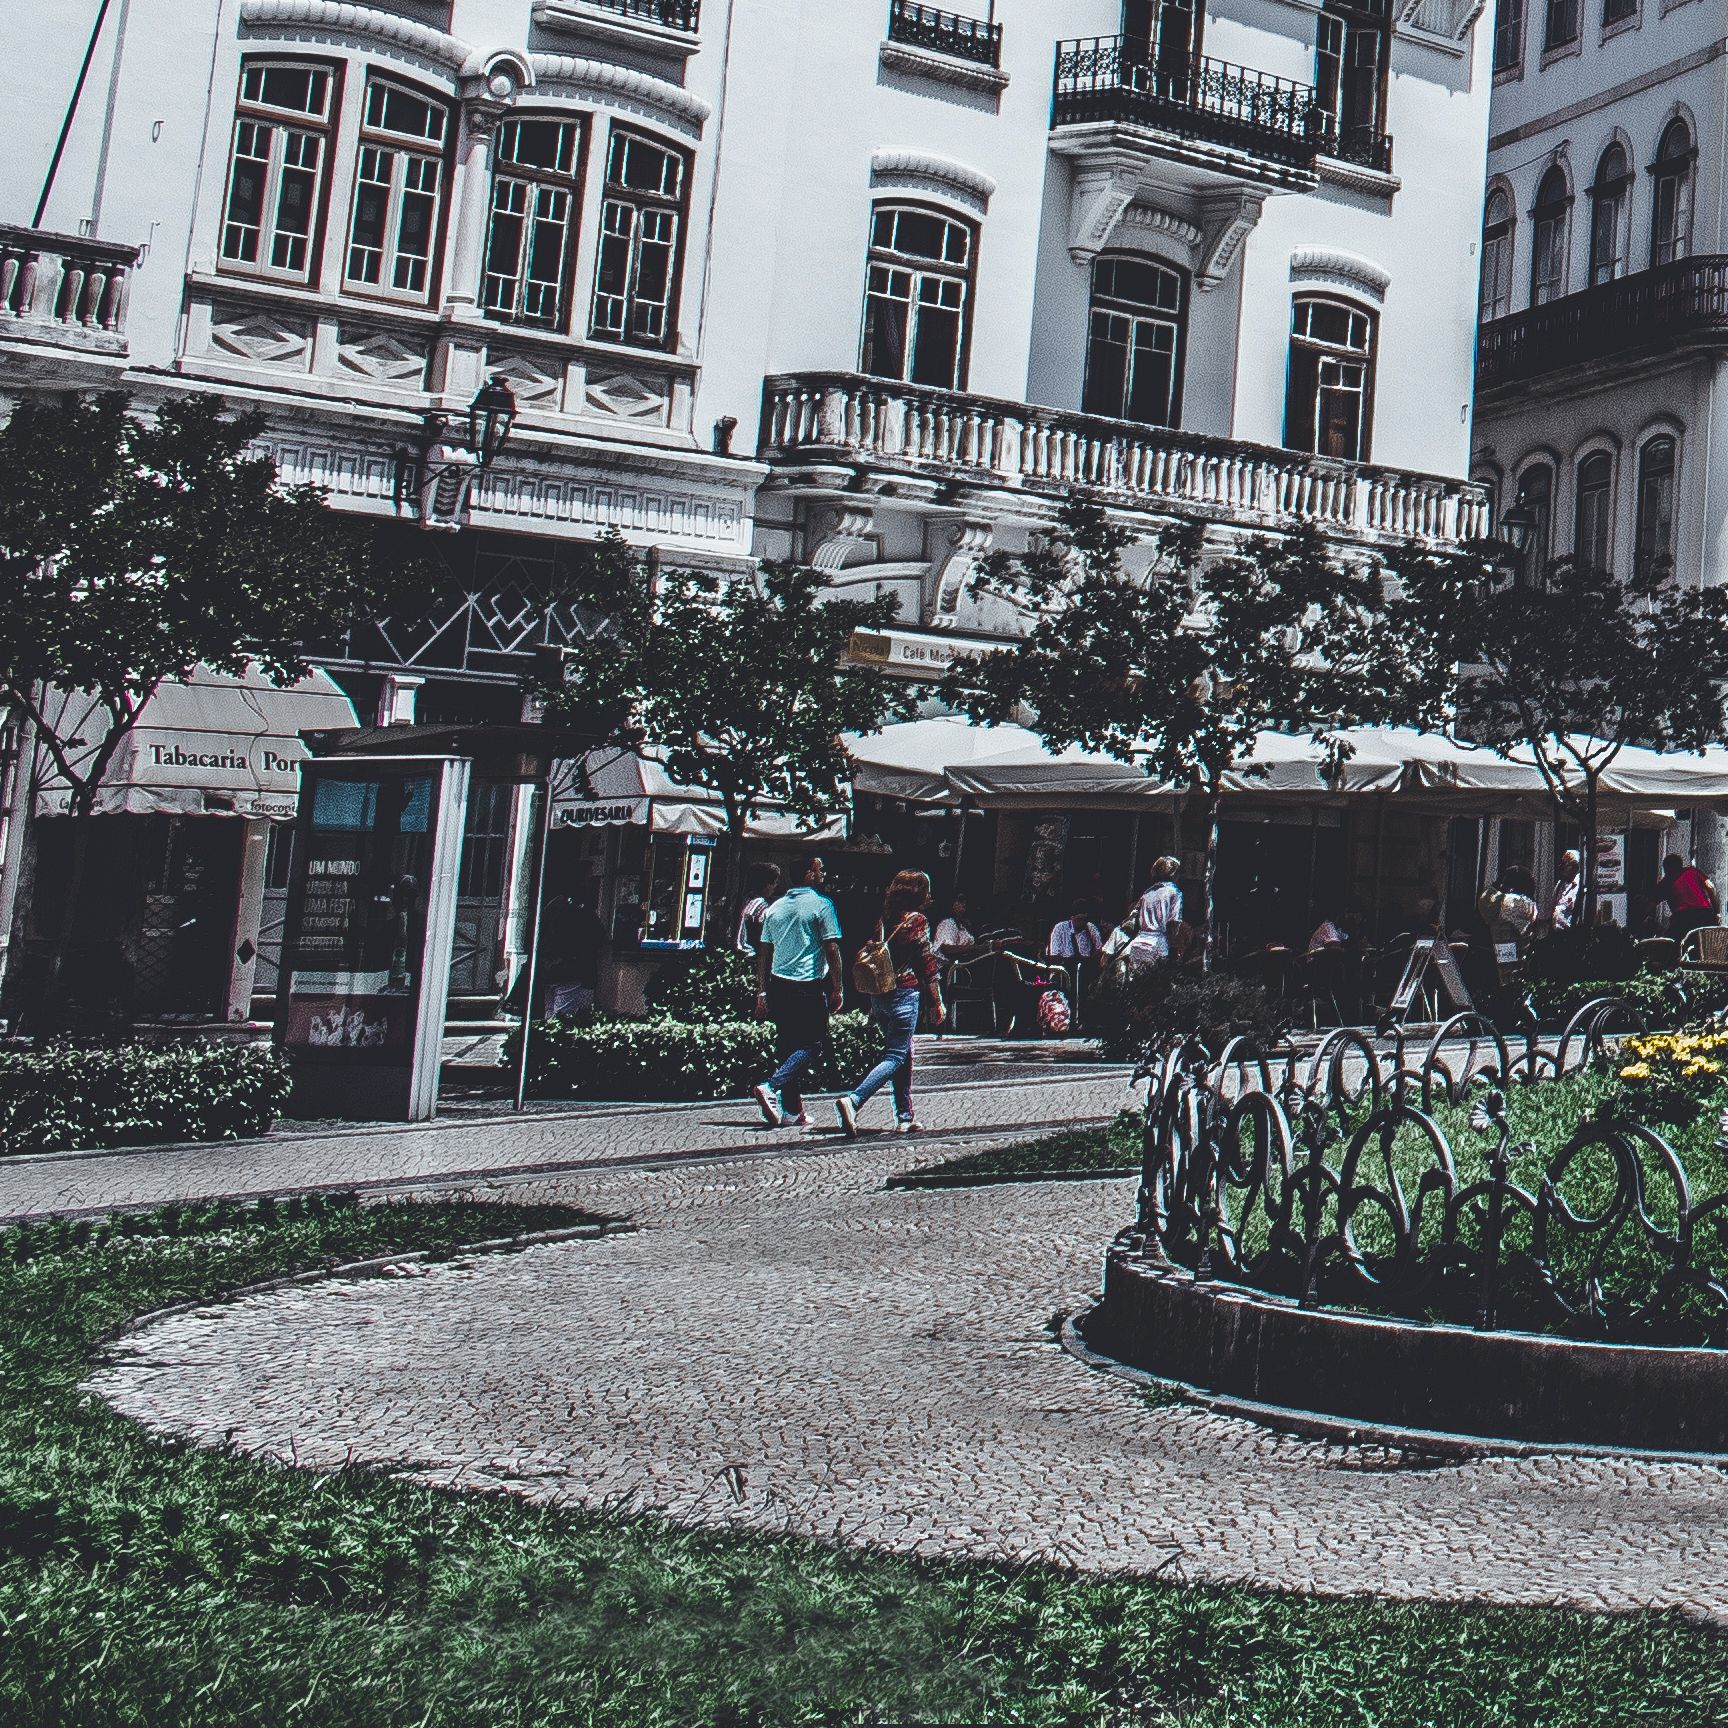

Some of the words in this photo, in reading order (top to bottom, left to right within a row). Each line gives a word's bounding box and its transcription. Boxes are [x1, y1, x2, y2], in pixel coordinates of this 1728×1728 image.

[902, 645, 926, 661] Café
[150, 744, 247, 770] Tabacaria
[308, 860, 325, 876] UM
[327, 860, 360, 876] MUNDO
[329, 898, 356, 914] FESTA
